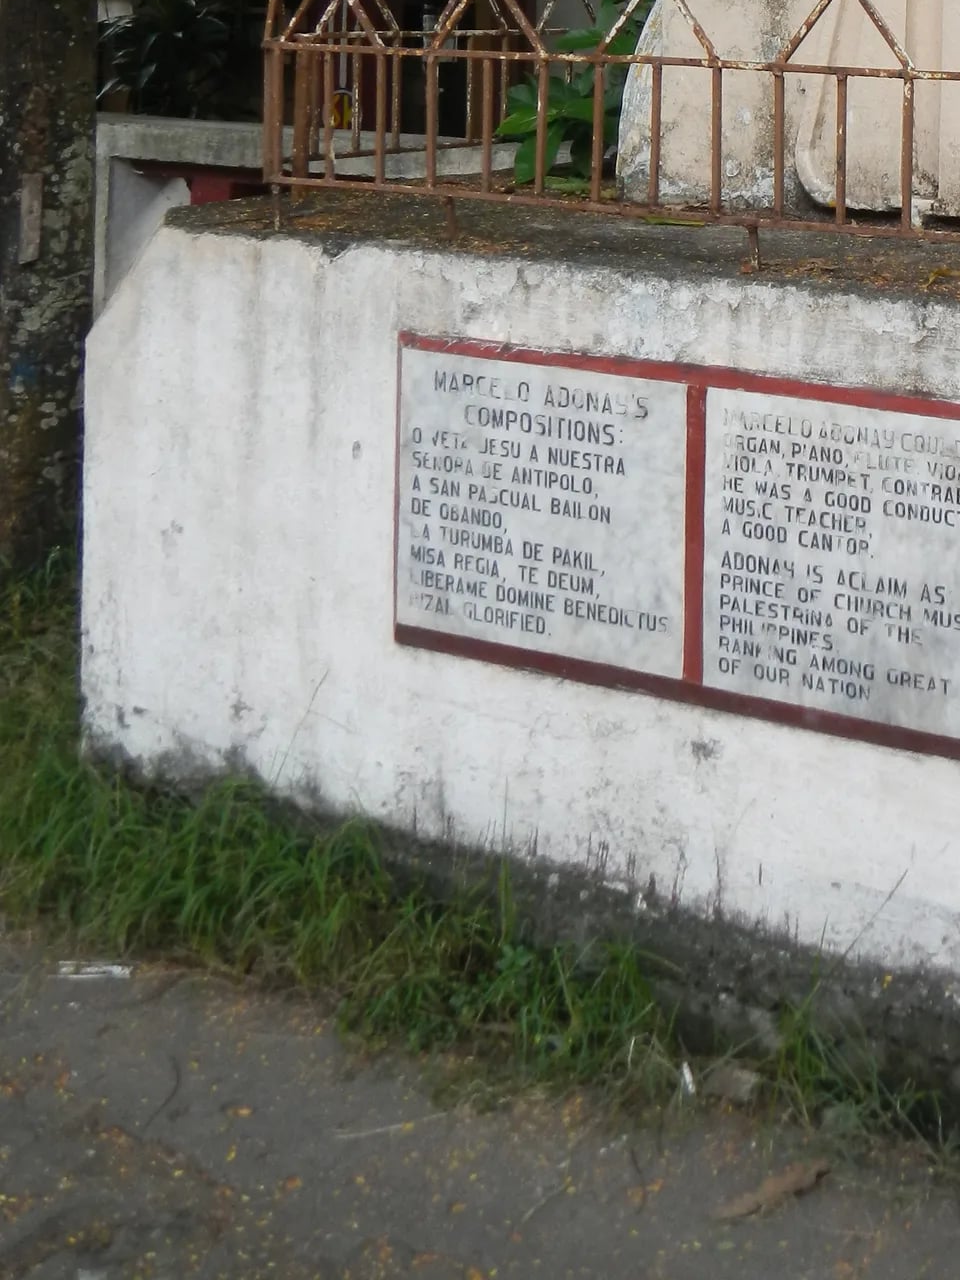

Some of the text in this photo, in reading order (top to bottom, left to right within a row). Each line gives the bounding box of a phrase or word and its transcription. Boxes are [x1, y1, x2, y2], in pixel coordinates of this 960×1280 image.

[434, 370, 530, 402] MARCELO
[464, 404, 623, 446] COMPOSITIONS:
[723, 408, 813, 439] MARCELO
[818, 421, 895, 449] ADONAY
[412, 427, 422, 444] O
[479, 438, 521, 459] JESU
[529, 444, 539, 463] A
[547, 446, 626, 477] NUESTRA
[411, 474, 611, 525] A SAN PASCUAL BAILON
[481, 460, 503, 481] DE
[511, 465, 599, 500] ANTIPOLO,
[722, 475, 745, 494] HE
[755, 480, 792, 501] WAS
[803, 488, 813, 503] A
[824, 491, 872, 514] GOOD
[411, 497, 508, 535] DE OBANDO,
[784, 505, 873, 539] TEACHER,
[440, 526, 514, 556] TURUMBA
[522, 540, 544, 563] DE
[552, 546, 605, 578] PAKIL,
[721, 518, 874, 559] A GOOD CANTOR.
[410, 544, 601, 601] MISA REGIA, TE DEUM,
[720, 550, 946, 606] ADONAY IS ACLAIM AS
[409, 568, 669, 634] LIBERAME DOMINE BENEDICTUS
[462, 601, 552, 637] GLORIFIED.
[720, 573, 785, 599] PRINCE
[798, 587, 821, 604] OF
[833, 593, 912, 622] CHURCH
[719, 594, 923, 646] PALESTRINA OF THE
[718, 657, 871, 701] OF OUR NATION
[809, 653, 875, 681] AMONG
[886, 668, 952, 696] GREAT
